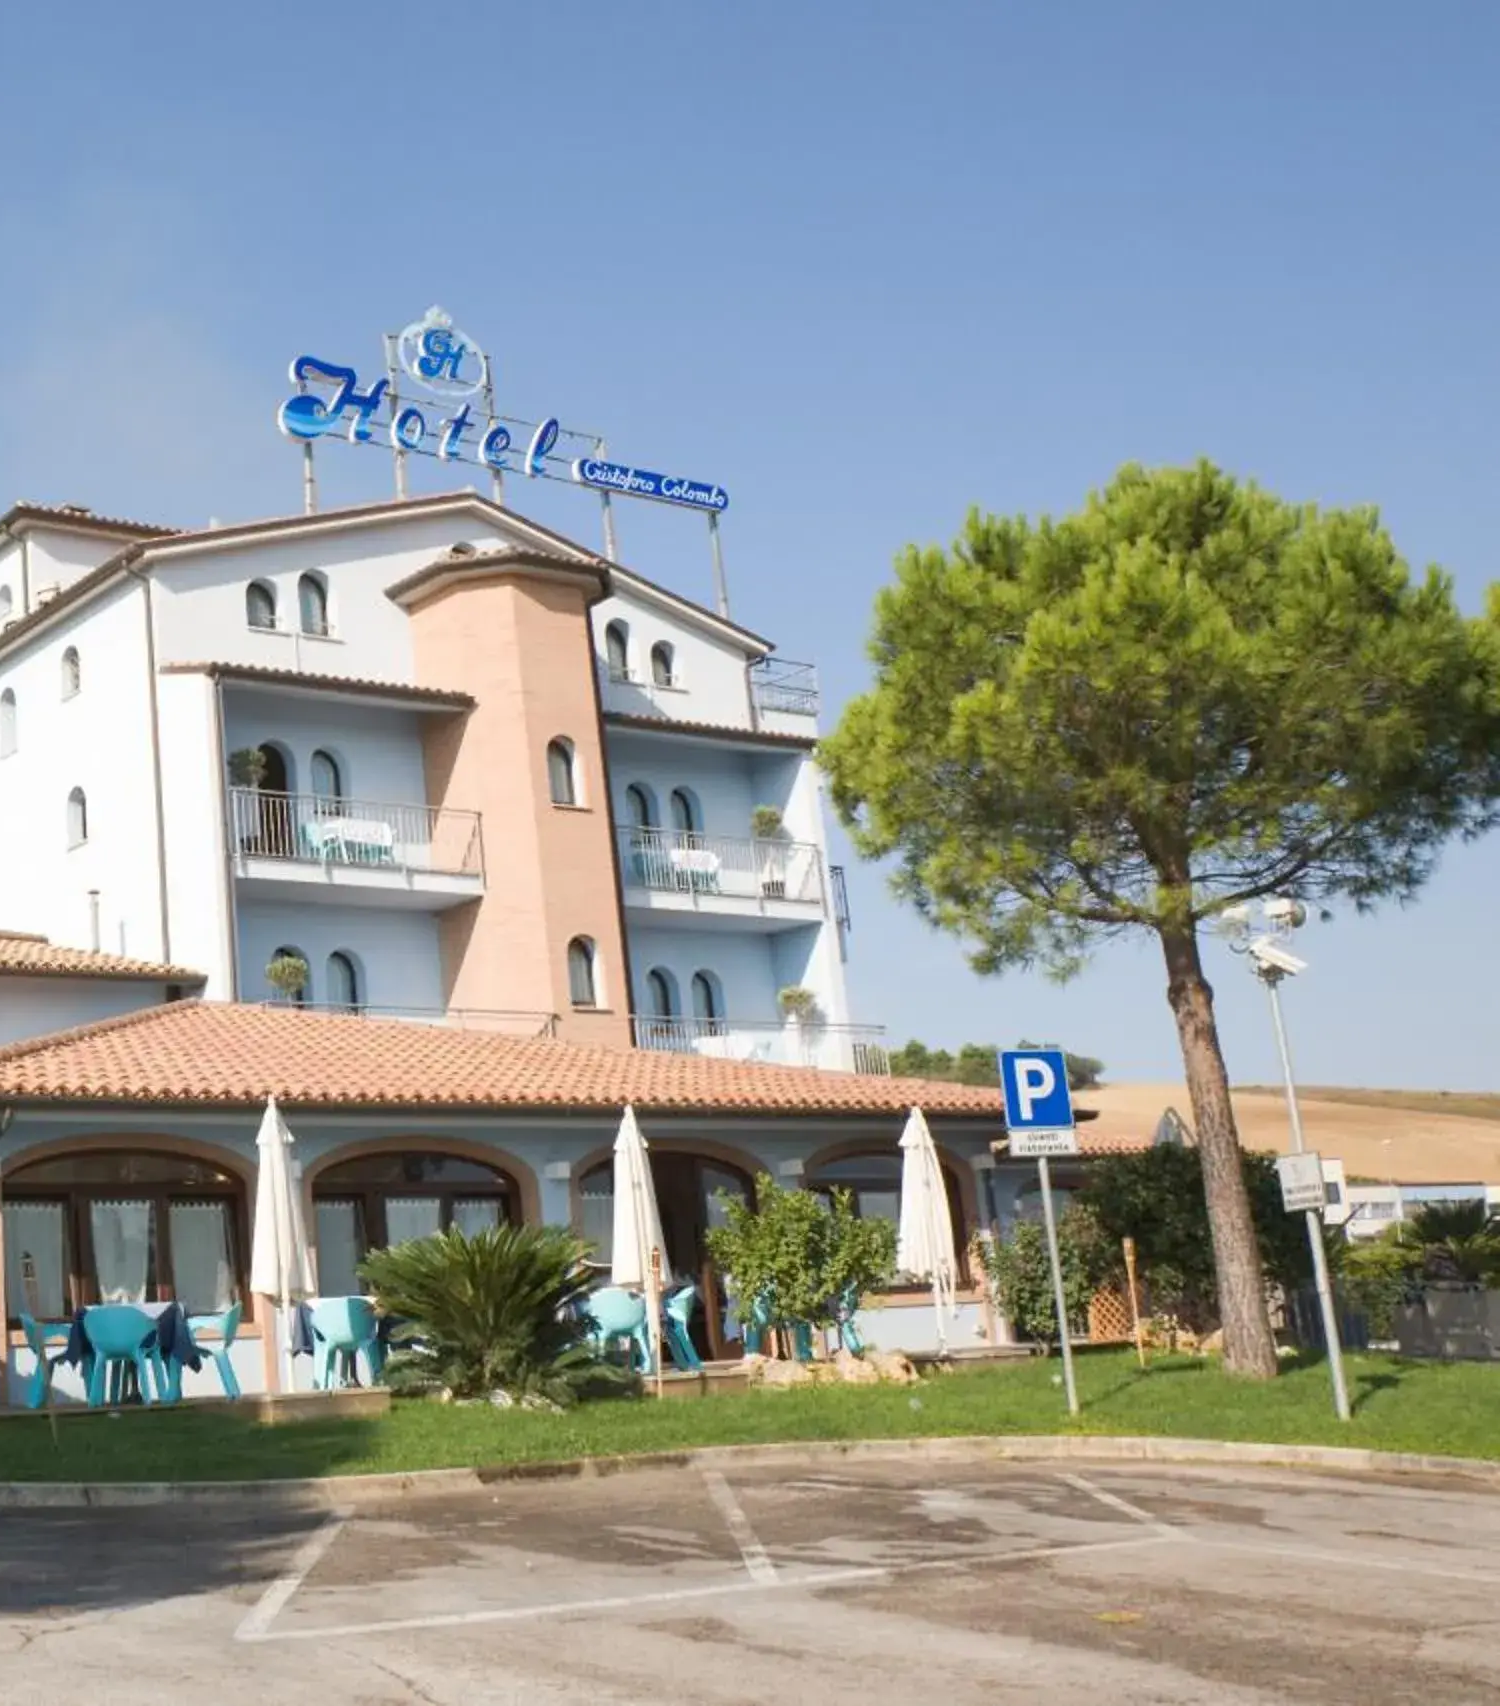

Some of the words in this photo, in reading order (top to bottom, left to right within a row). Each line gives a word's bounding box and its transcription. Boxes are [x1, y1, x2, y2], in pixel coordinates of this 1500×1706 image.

[279, 355, 559, 477] Hotel
[584, 461, 654, 492] Cristoforo
[661, 476, 725, 507] Colombo
[1014, 1058, 1056, 1121] P
